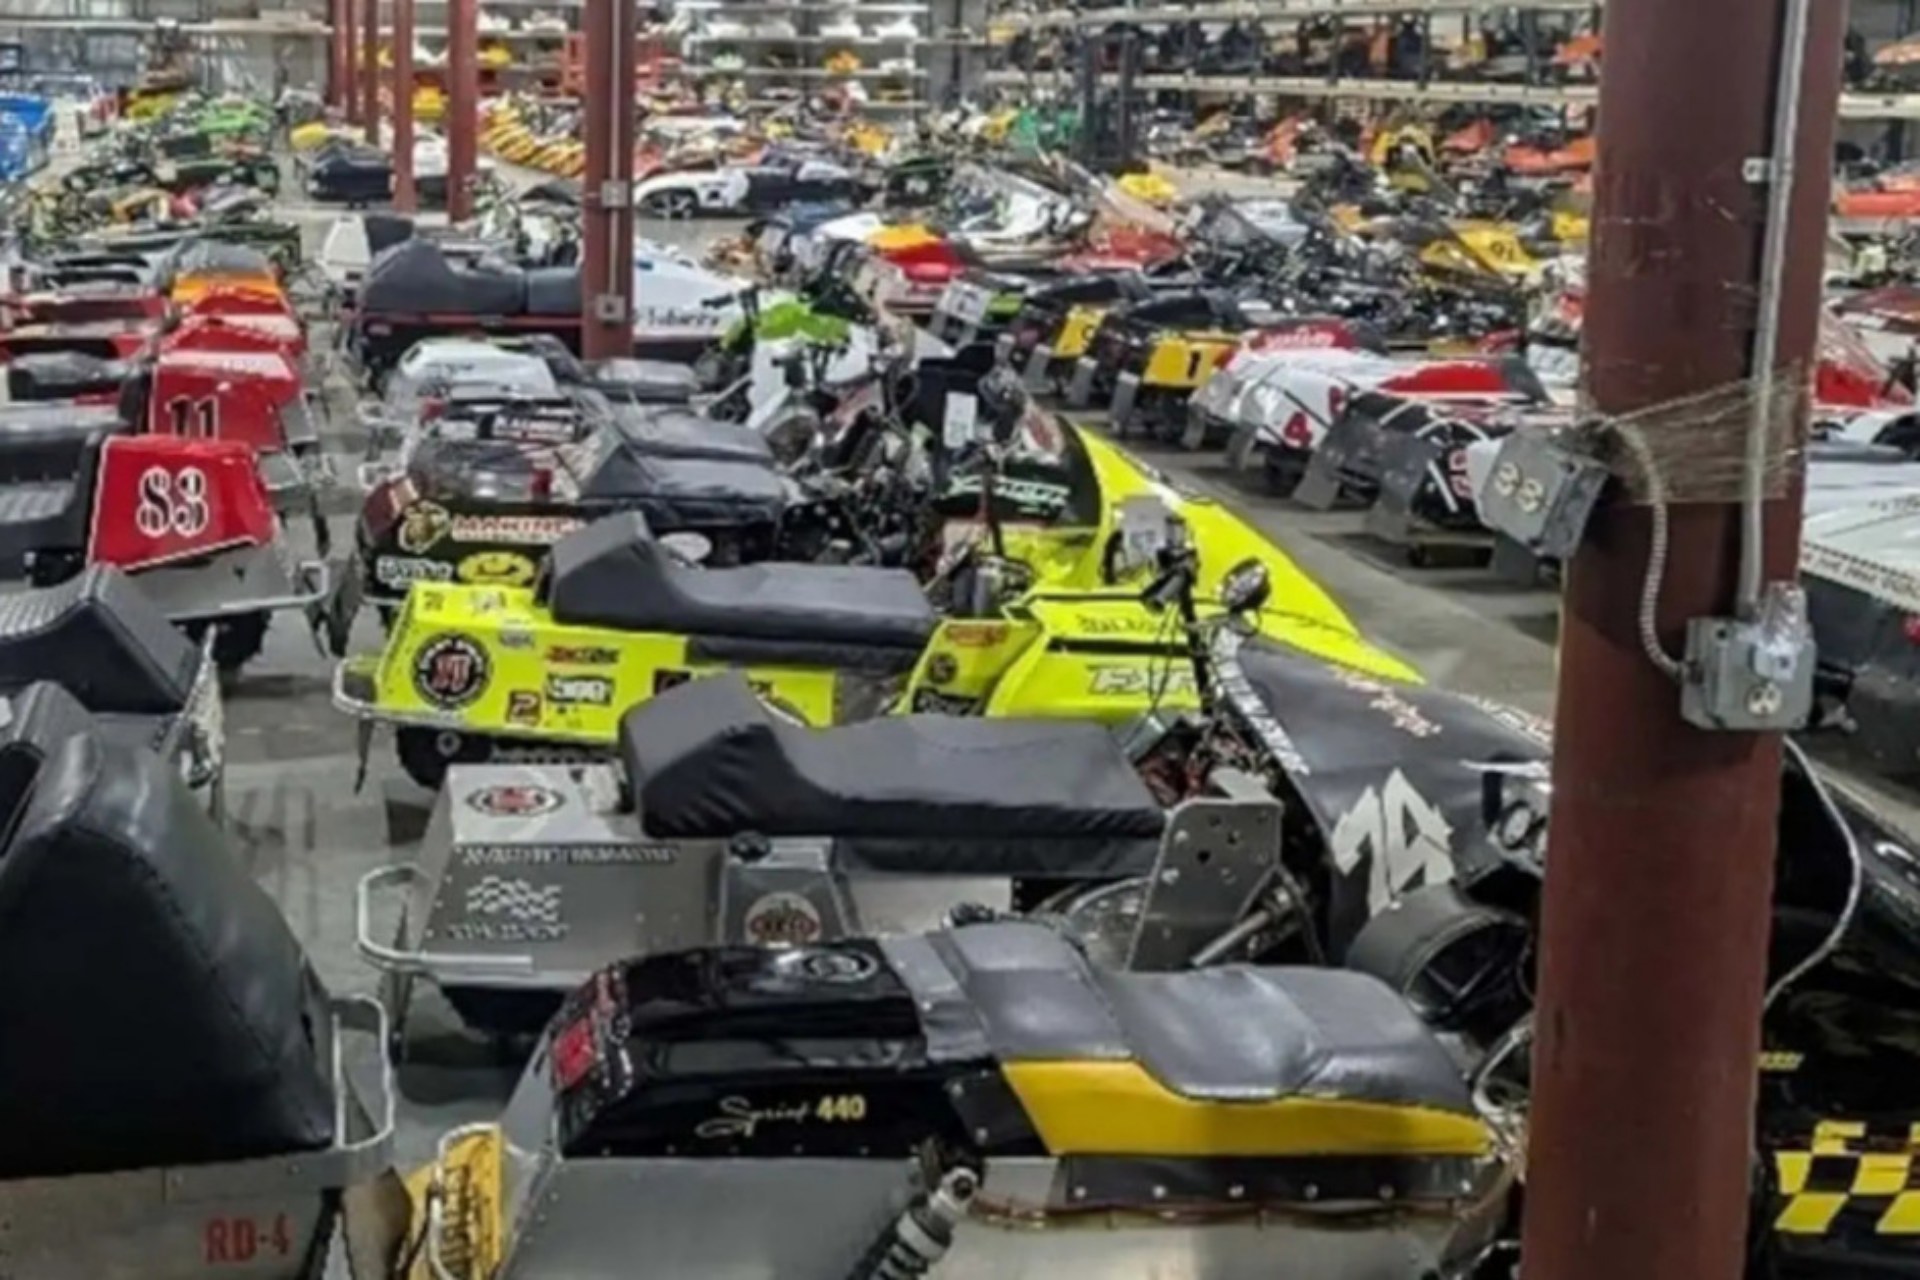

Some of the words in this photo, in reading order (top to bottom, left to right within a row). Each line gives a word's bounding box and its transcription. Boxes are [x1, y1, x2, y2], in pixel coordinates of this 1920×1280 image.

[136, 465, 208, 537] 83
[816, 1095, 866, 1121] 440
[206, 1213, 290, 1264] RD-4
